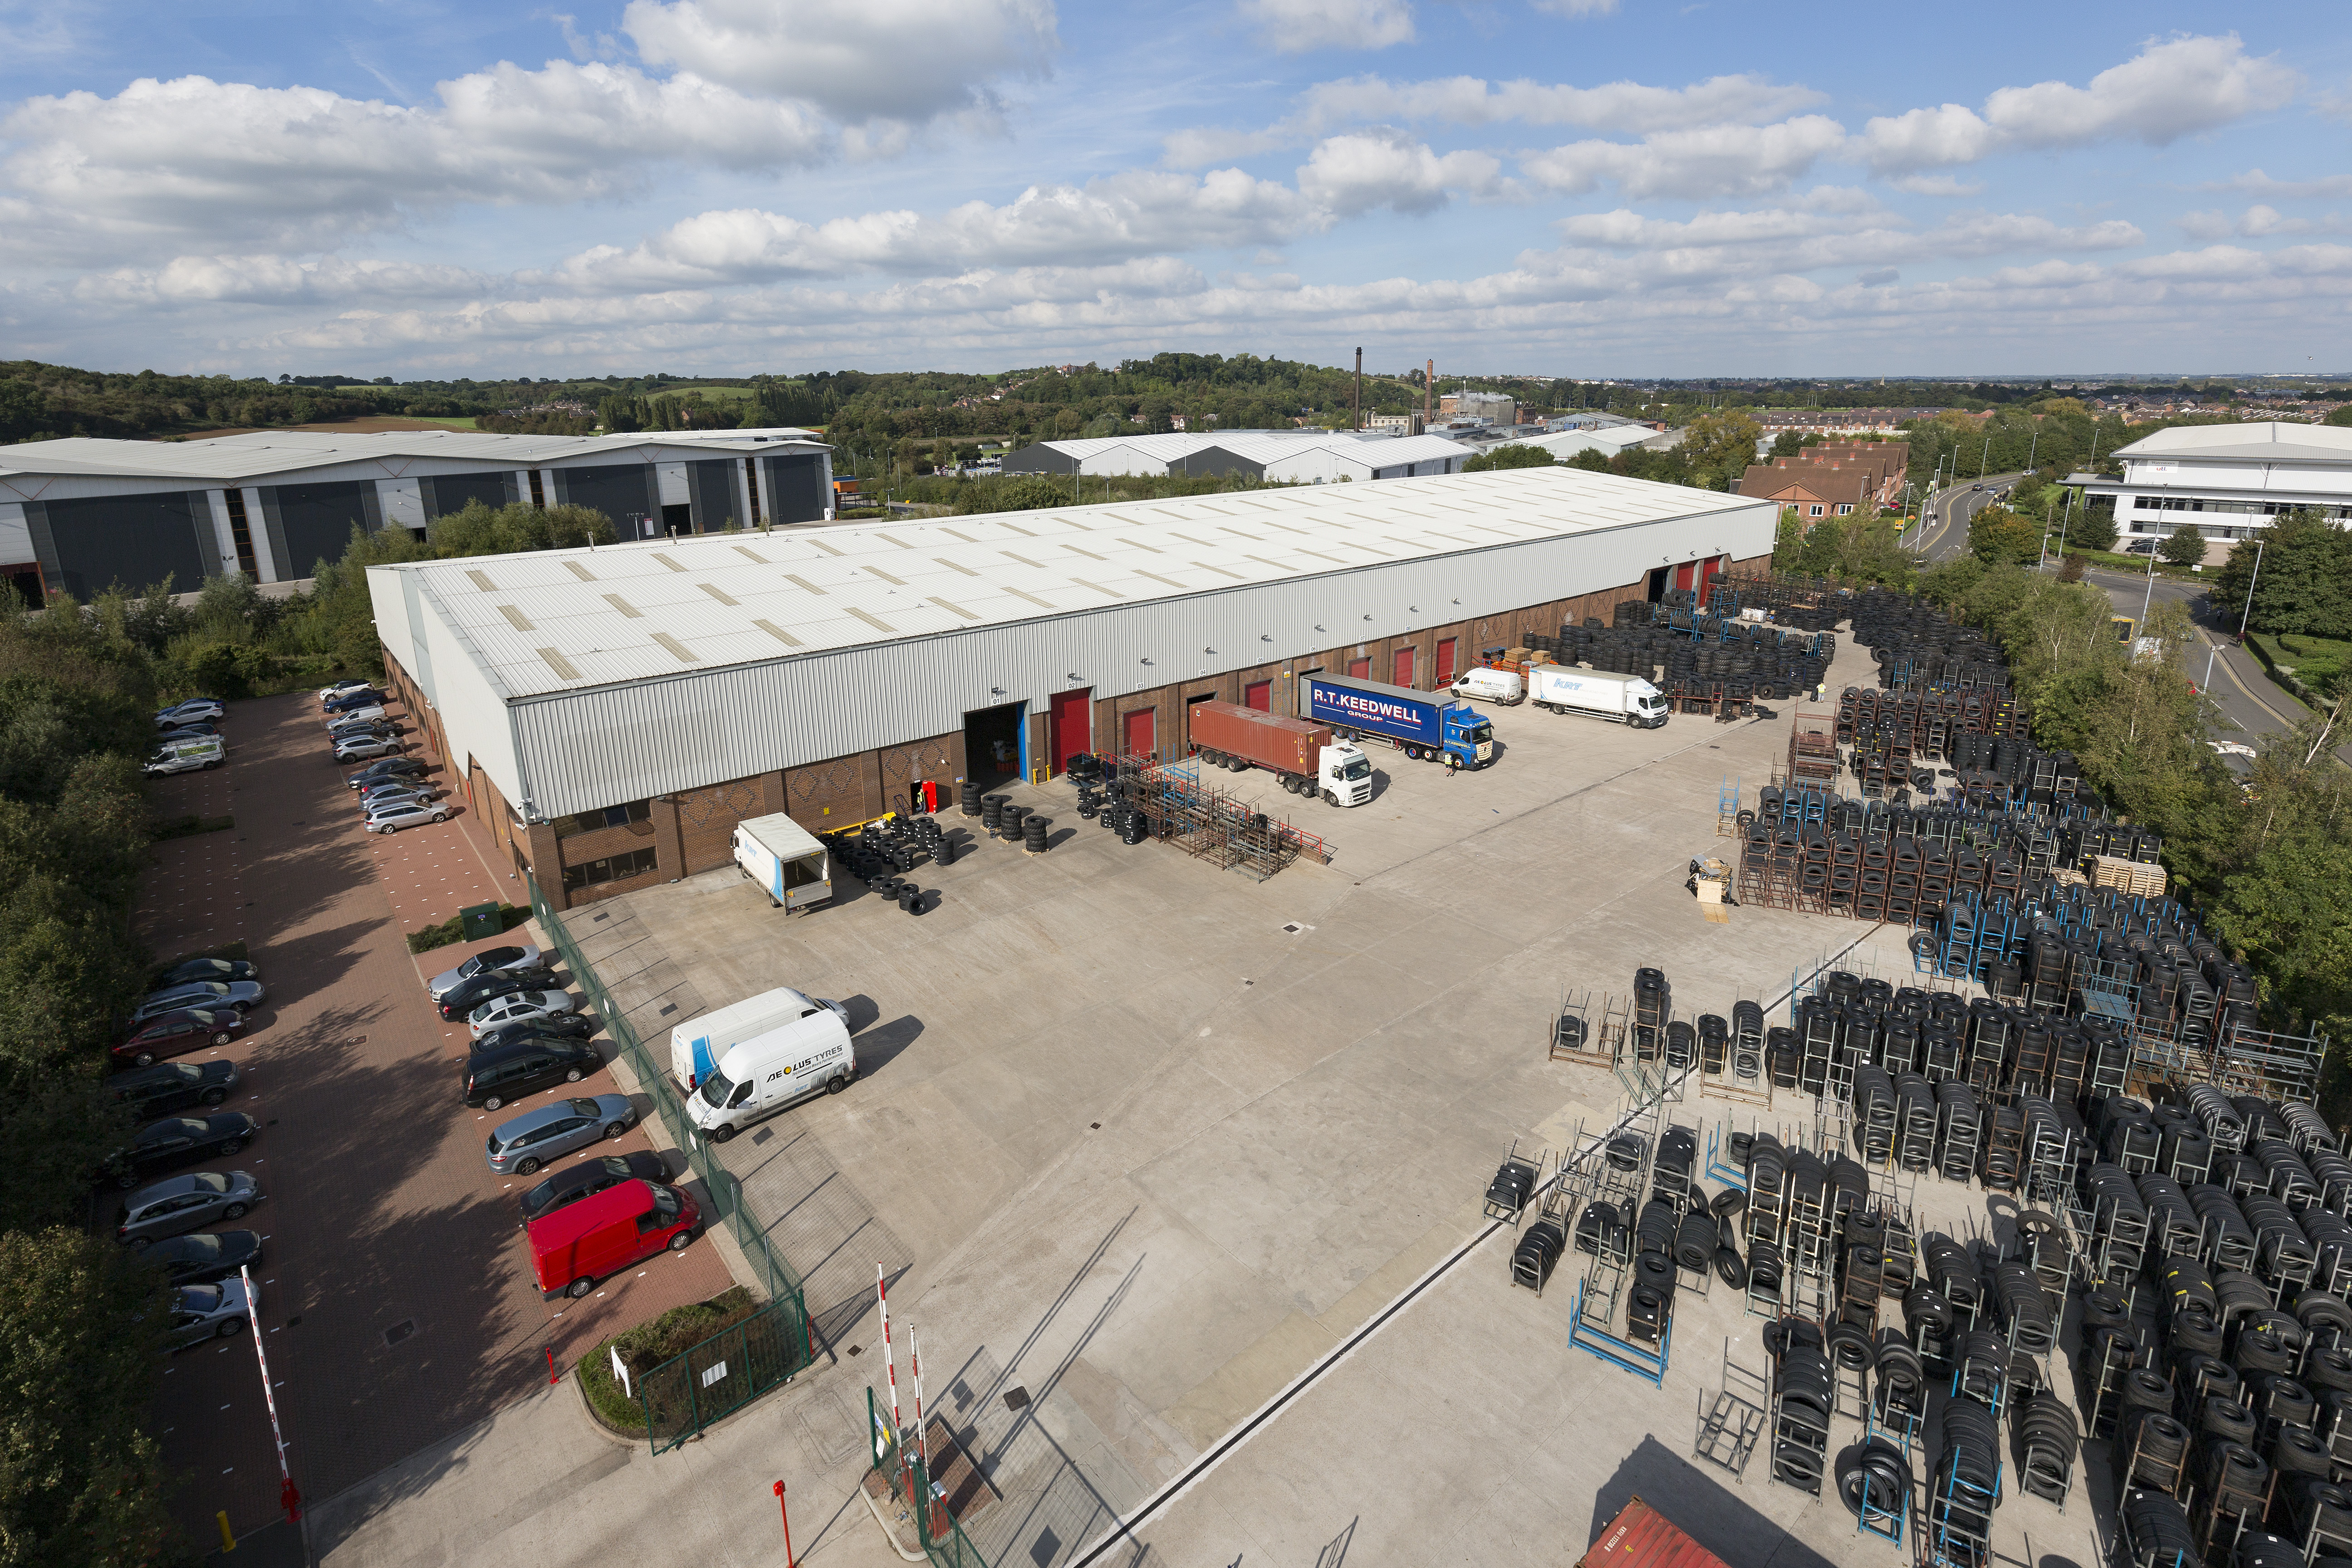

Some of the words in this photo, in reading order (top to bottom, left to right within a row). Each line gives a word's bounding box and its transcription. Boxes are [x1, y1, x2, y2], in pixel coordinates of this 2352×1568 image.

[1314, 689, 1422, 725] R.T.KEEDWELL
[1347, 710, 1384, 721] GROUP
[813, 1044, 843, 1062] TYRES
[792, 1064, 811, 1077] Technology
[822, 1052, 843, 1064] Performance
